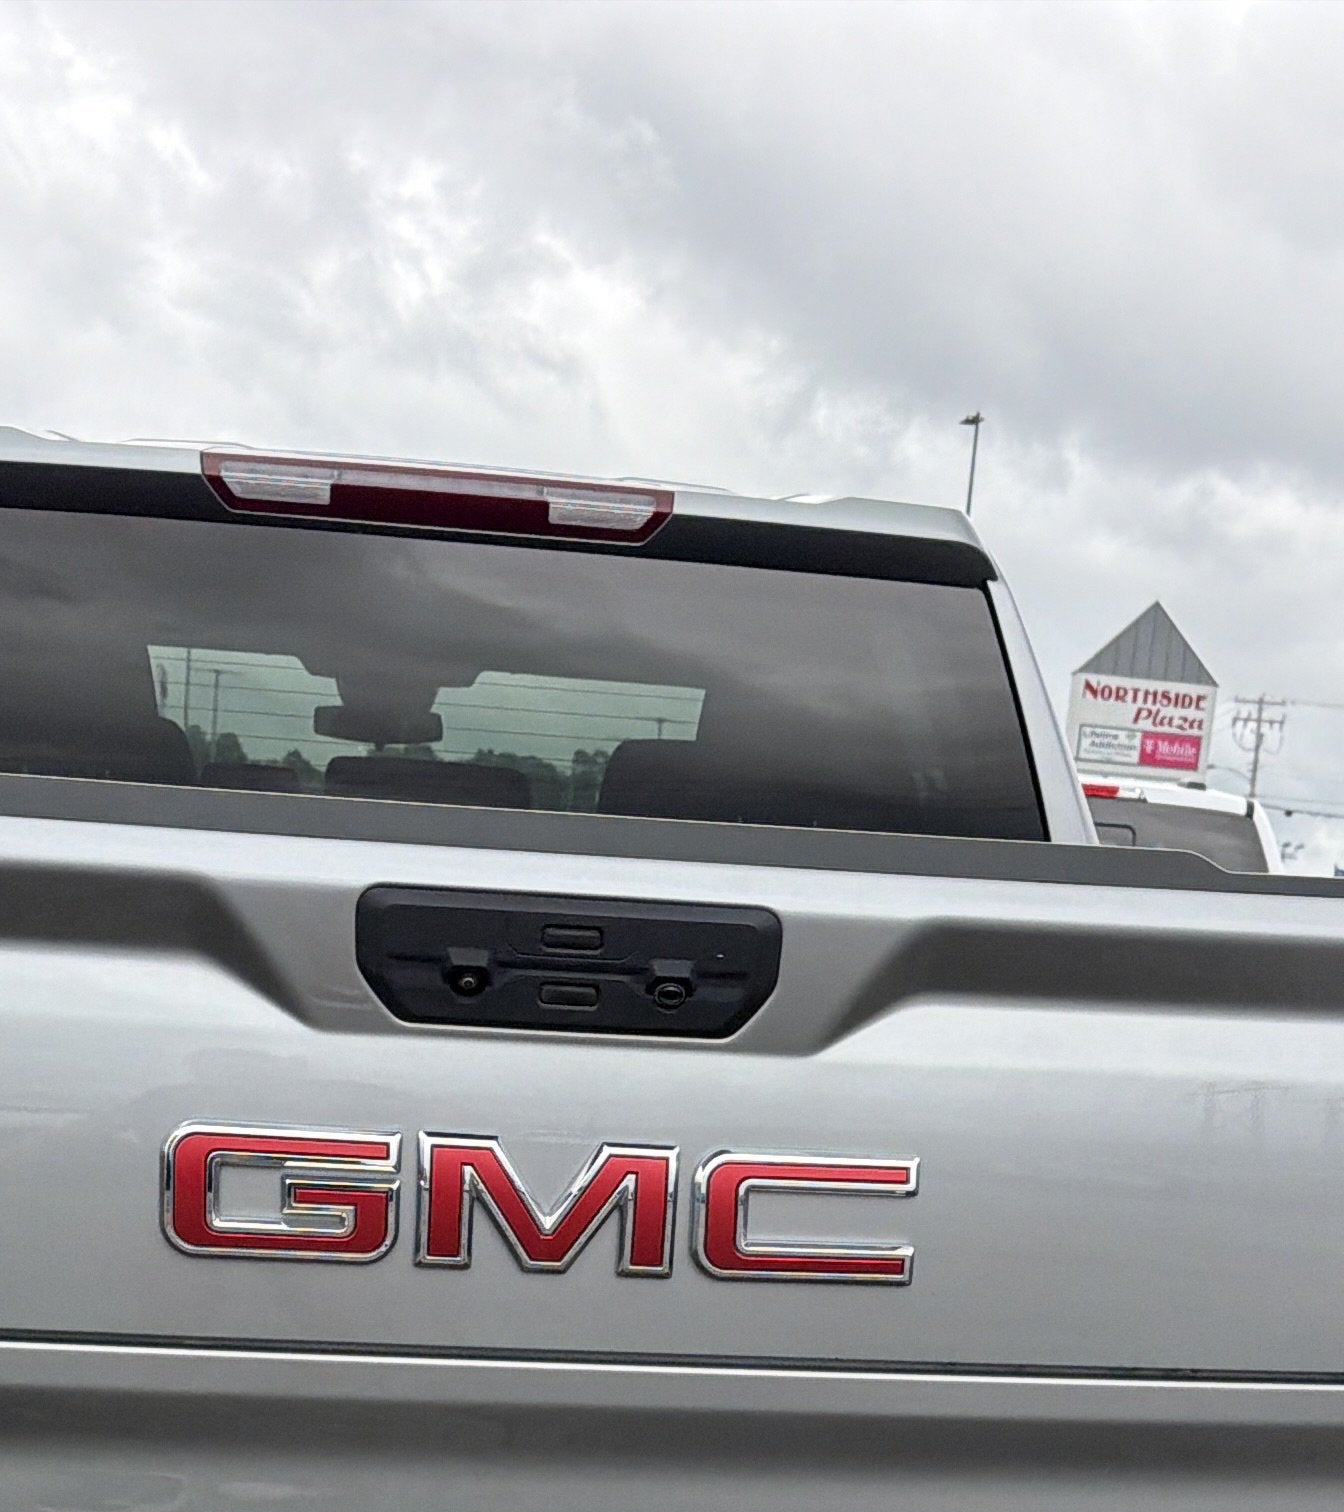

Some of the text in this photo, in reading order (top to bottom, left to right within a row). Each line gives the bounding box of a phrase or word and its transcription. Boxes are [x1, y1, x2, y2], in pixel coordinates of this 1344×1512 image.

[1083, 678, 1208, 711] NORTHSIDE
[1132, 706, 1205, 731] Plaza
[160, 1119, 920, 1286] GMC
